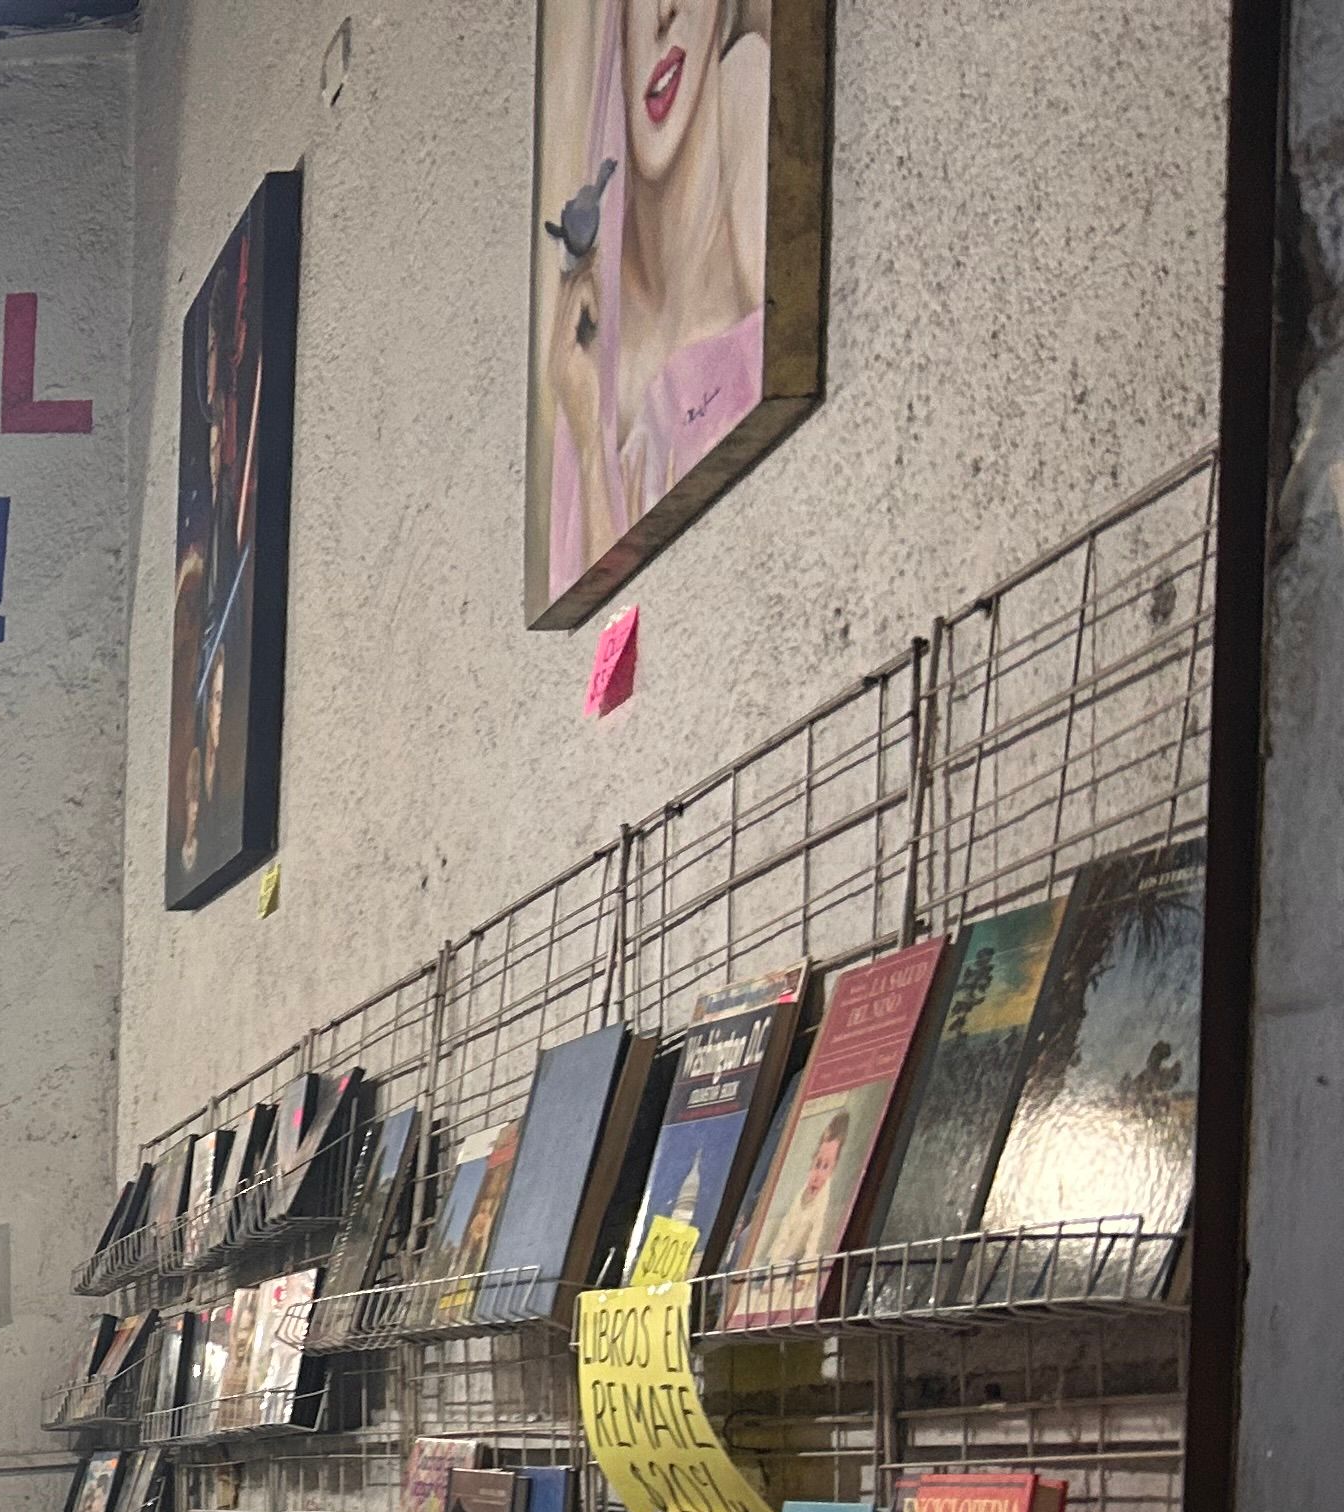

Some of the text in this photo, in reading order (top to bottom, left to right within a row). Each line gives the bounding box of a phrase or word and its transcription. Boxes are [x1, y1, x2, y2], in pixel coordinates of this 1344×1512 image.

[582, 1304, 690, 1374] LIBROS EN
[591, 1379, 718, 1451] REMATE
